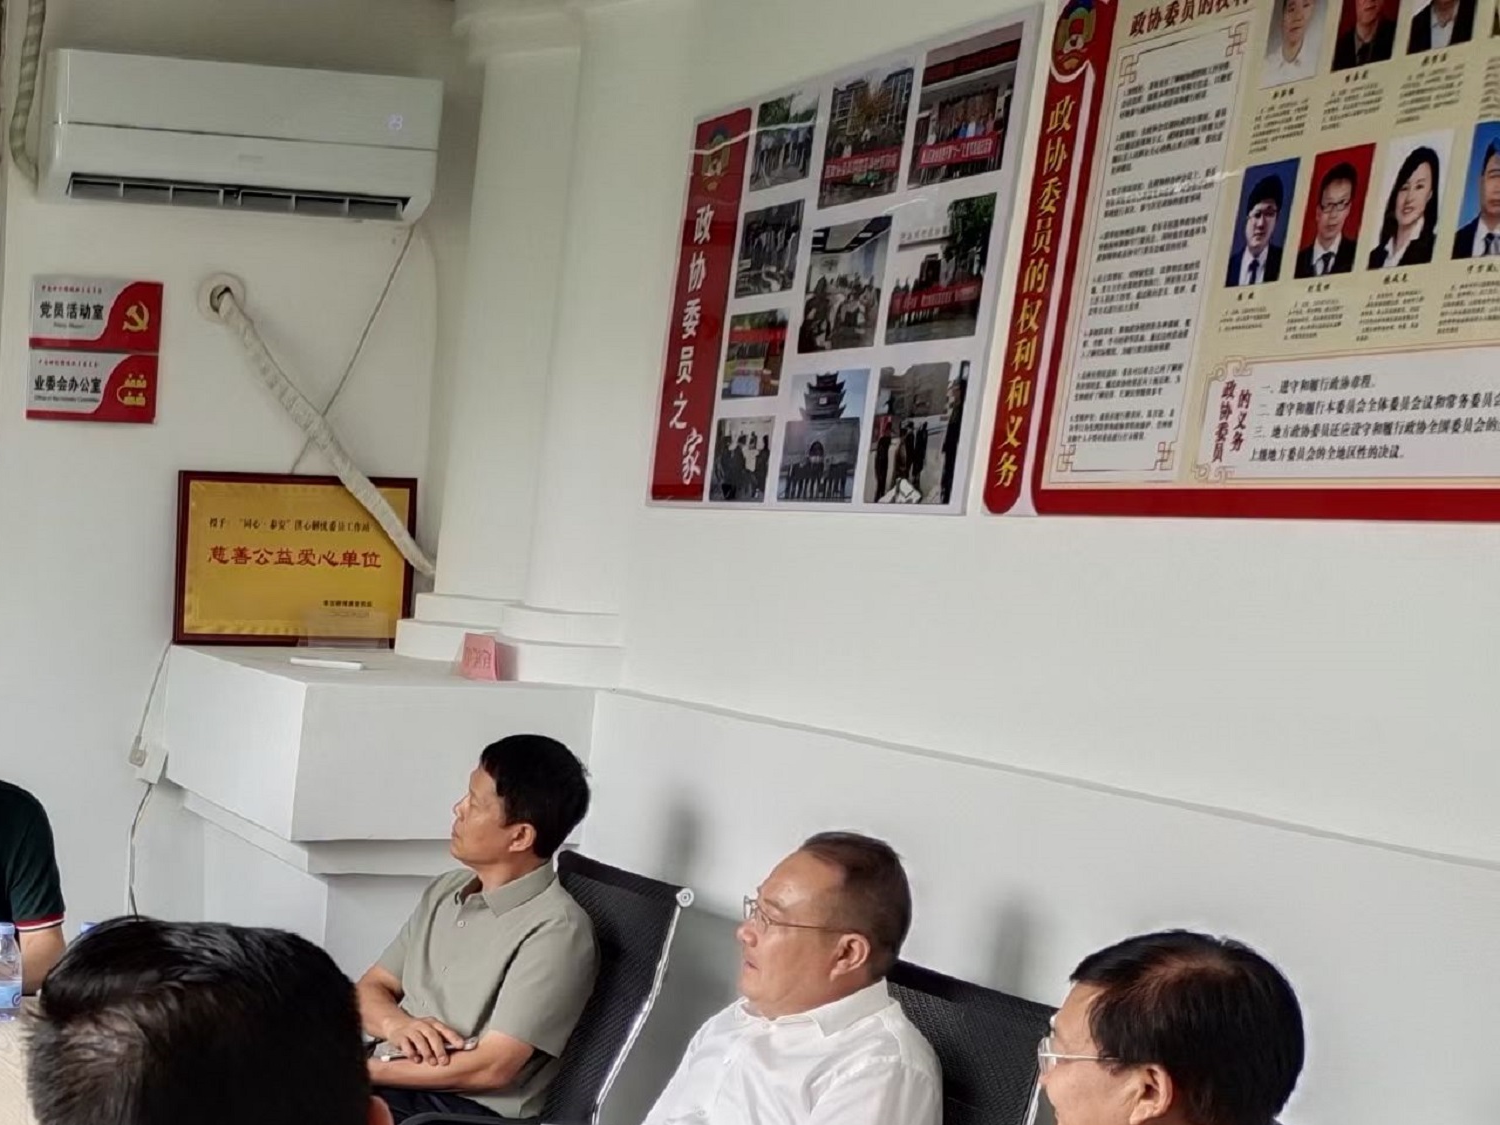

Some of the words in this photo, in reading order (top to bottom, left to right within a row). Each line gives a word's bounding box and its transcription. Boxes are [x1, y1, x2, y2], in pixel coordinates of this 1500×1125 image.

[39, 301, 104, 321] 党员活动室
[995, 95, 1074, 488] 政协委员的权利和义务
[668, 204, 716, 485] 政协委员之家
[34, 374, 102, 394] 业委会办公室
[1212, 379, 1237, 463] 政协委员
[1229, 389, 1252, 451] 的义务
[208, 545, 382, 568] 慈善公益爱心单位
